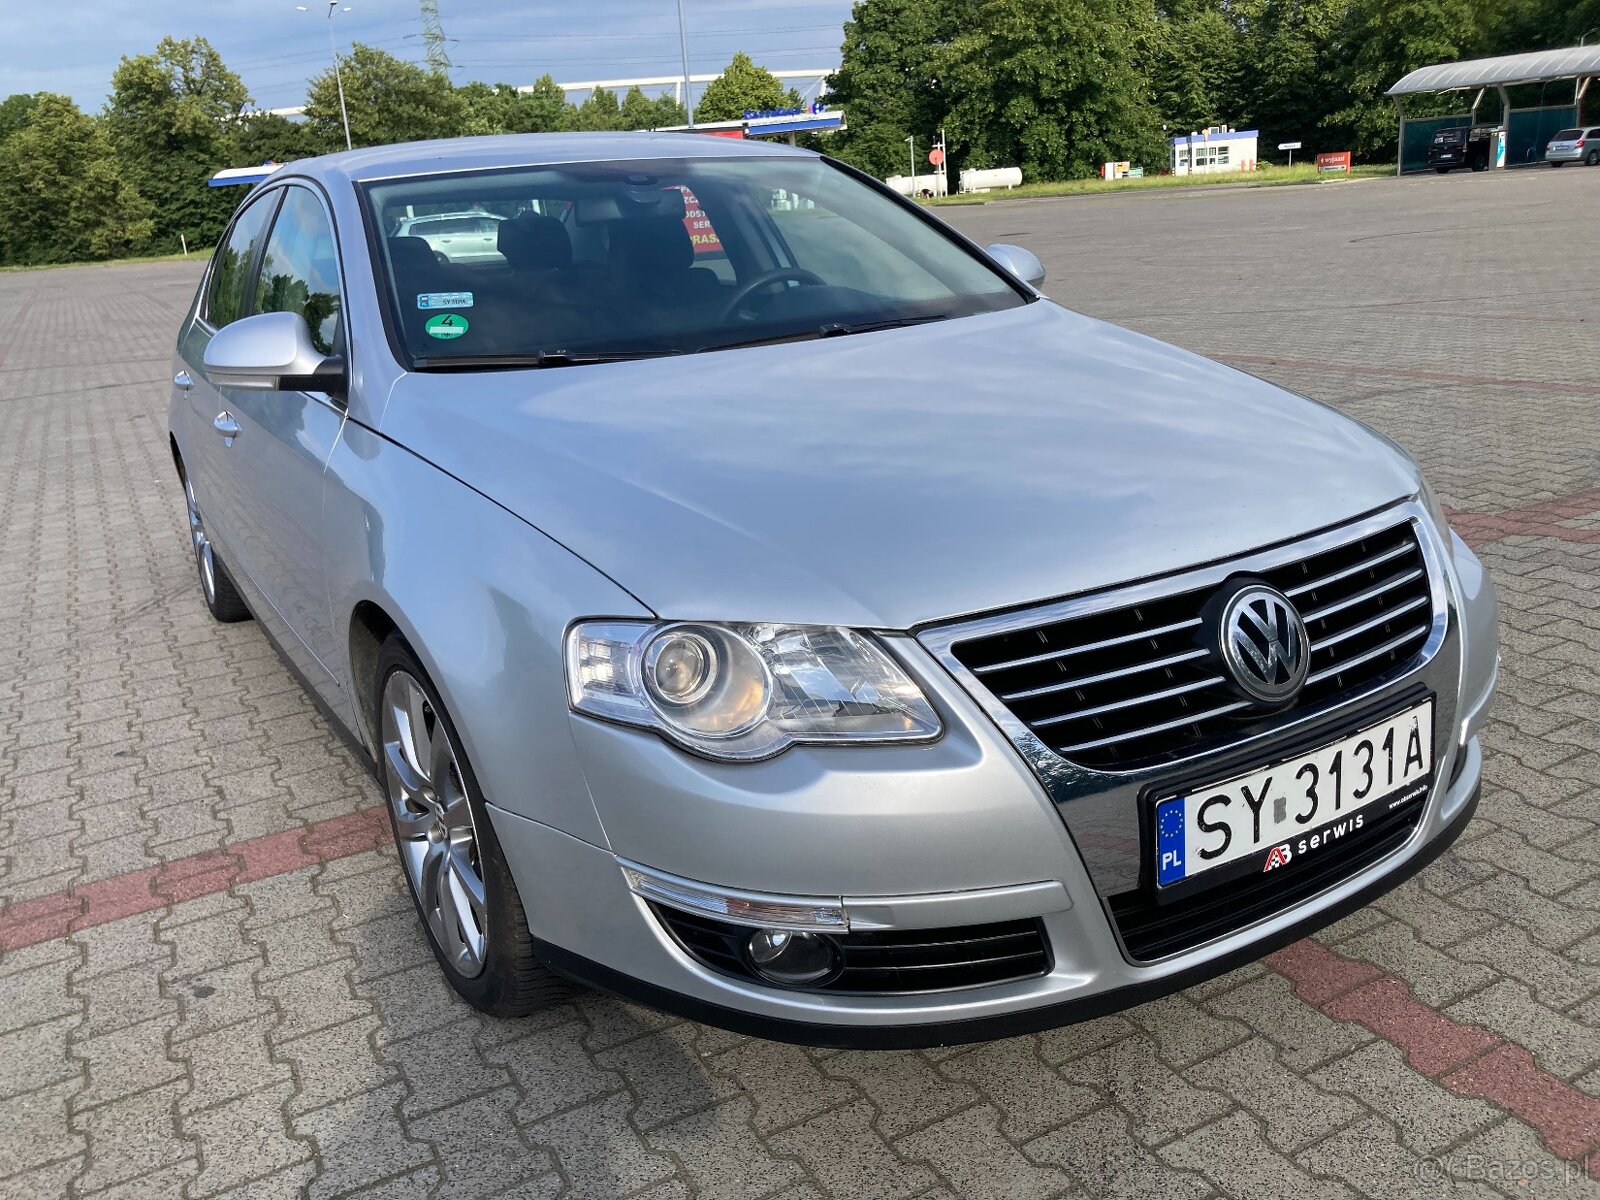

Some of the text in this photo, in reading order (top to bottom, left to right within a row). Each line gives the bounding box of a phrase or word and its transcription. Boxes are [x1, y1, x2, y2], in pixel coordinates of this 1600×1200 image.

[441, 314, 454, 327] 4
[1197, 715, 1424, 860] SY 3131A
[1298, 814, 1364, 855] serwis
[1162, 849, 1182, 871] PL
